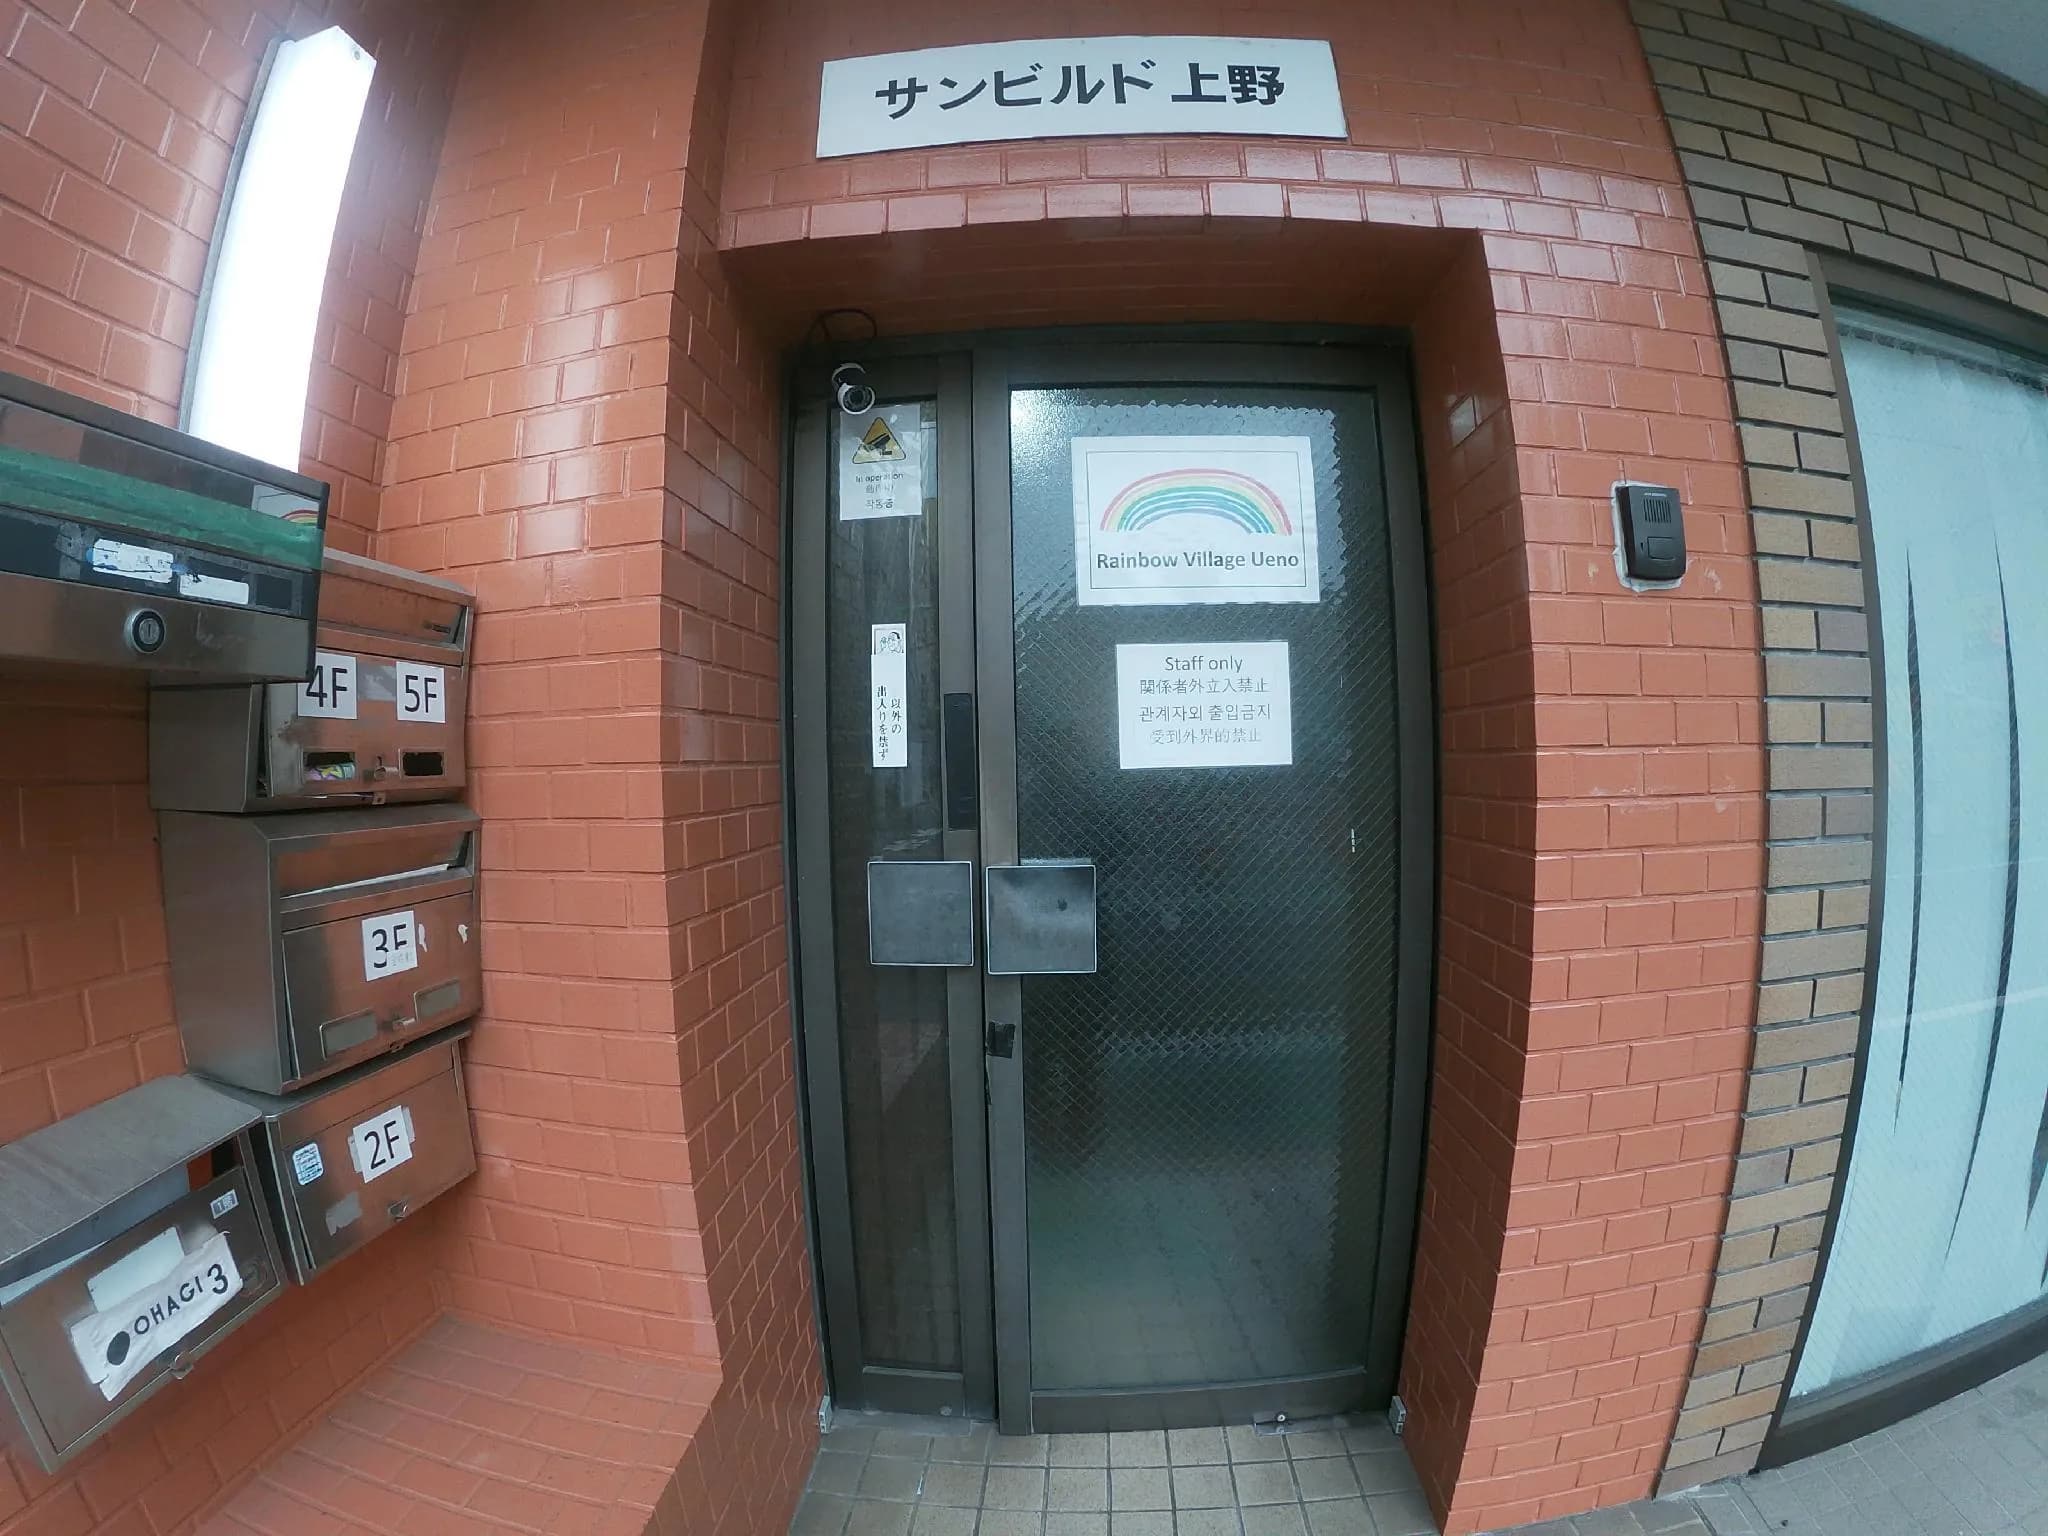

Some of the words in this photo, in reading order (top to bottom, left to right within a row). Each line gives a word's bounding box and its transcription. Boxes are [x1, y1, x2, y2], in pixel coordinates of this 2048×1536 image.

[875, 58, 1157, 120] サンビルド
[1171, 62, 1286, 105] 上野
[1097, 551, 1178, 569] Rainbow
[1183, 550, 1246, 571] Village
[1251, 551, 1299, 567] Ueno
[1165, 655, 1205, 671] Staff
[1208, 655, 1243, 673] only
[306, 665, 348, 708] 4F
[404, 674, 437, 713] 5F
[1139, 676, 1271, 695] 関係者外立入禁止
[891, 698, 902, 734] 以外の
[1138, 705, 1203, 722] 관계자외
[1207, 703, 1272, 721] 출입금지
[372, 923, 407, 969] 3F
[364, 1120, 400, 1170] 2F
[134, 1275, 204, 1335] OHAGI
[207, 1263, 229, 1295] 3
